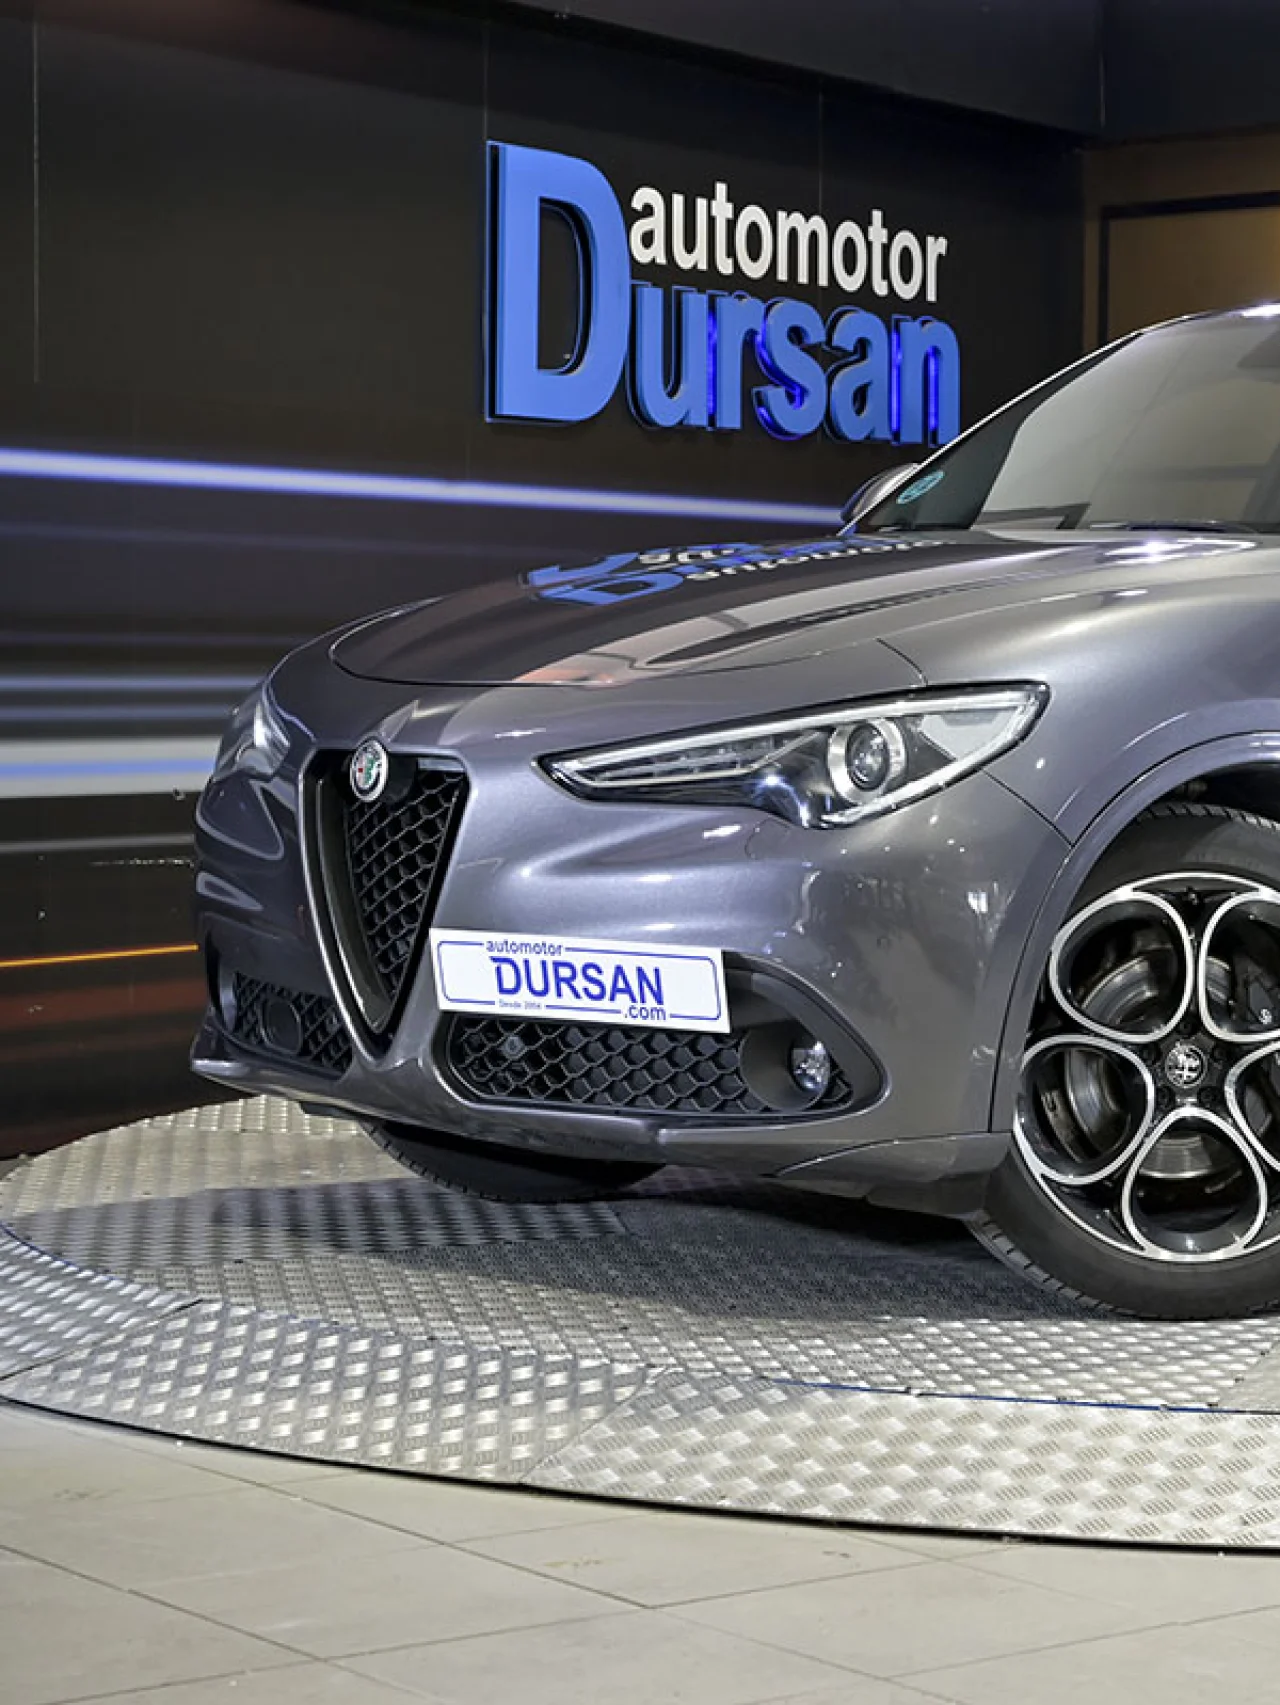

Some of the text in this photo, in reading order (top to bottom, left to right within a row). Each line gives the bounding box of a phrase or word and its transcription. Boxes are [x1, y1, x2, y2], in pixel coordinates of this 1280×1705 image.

[629, 180, 948, 302] automotor
[485, 140, 961, 448] Dursan
[486, 939, 564, 956] automotor
[488, 955, 665, 1005] DURSAN
[623, 1003, 667, 1020] .com
